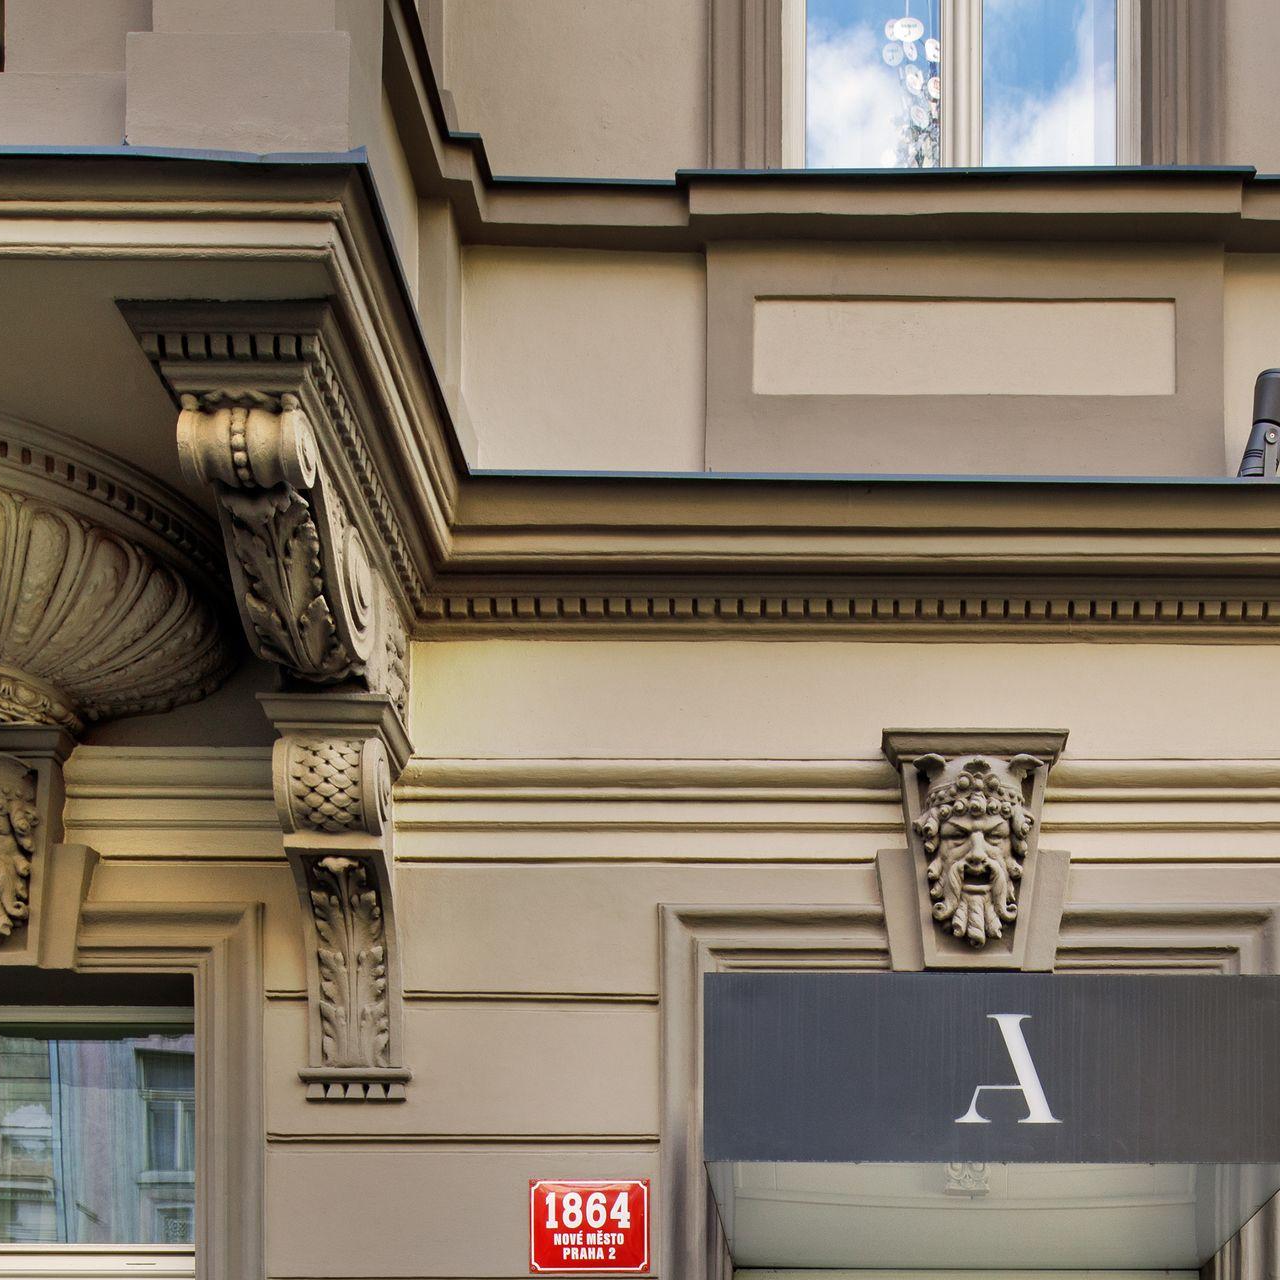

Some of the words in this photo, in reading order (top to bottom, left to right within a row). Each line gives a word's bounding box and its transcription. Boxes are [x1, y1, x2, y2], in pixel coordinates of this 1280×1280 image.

[954, 1013, 1064, 1124] A
[545, 1191, 631, 1229] 1864
[553, 1230, 584, 1246] NOVÉ
[586, 1229, 625, 1246] MĚSTO
[562, 1247, 605, 1260] PRAHA
[608, 1247, 617, 1260] 2
